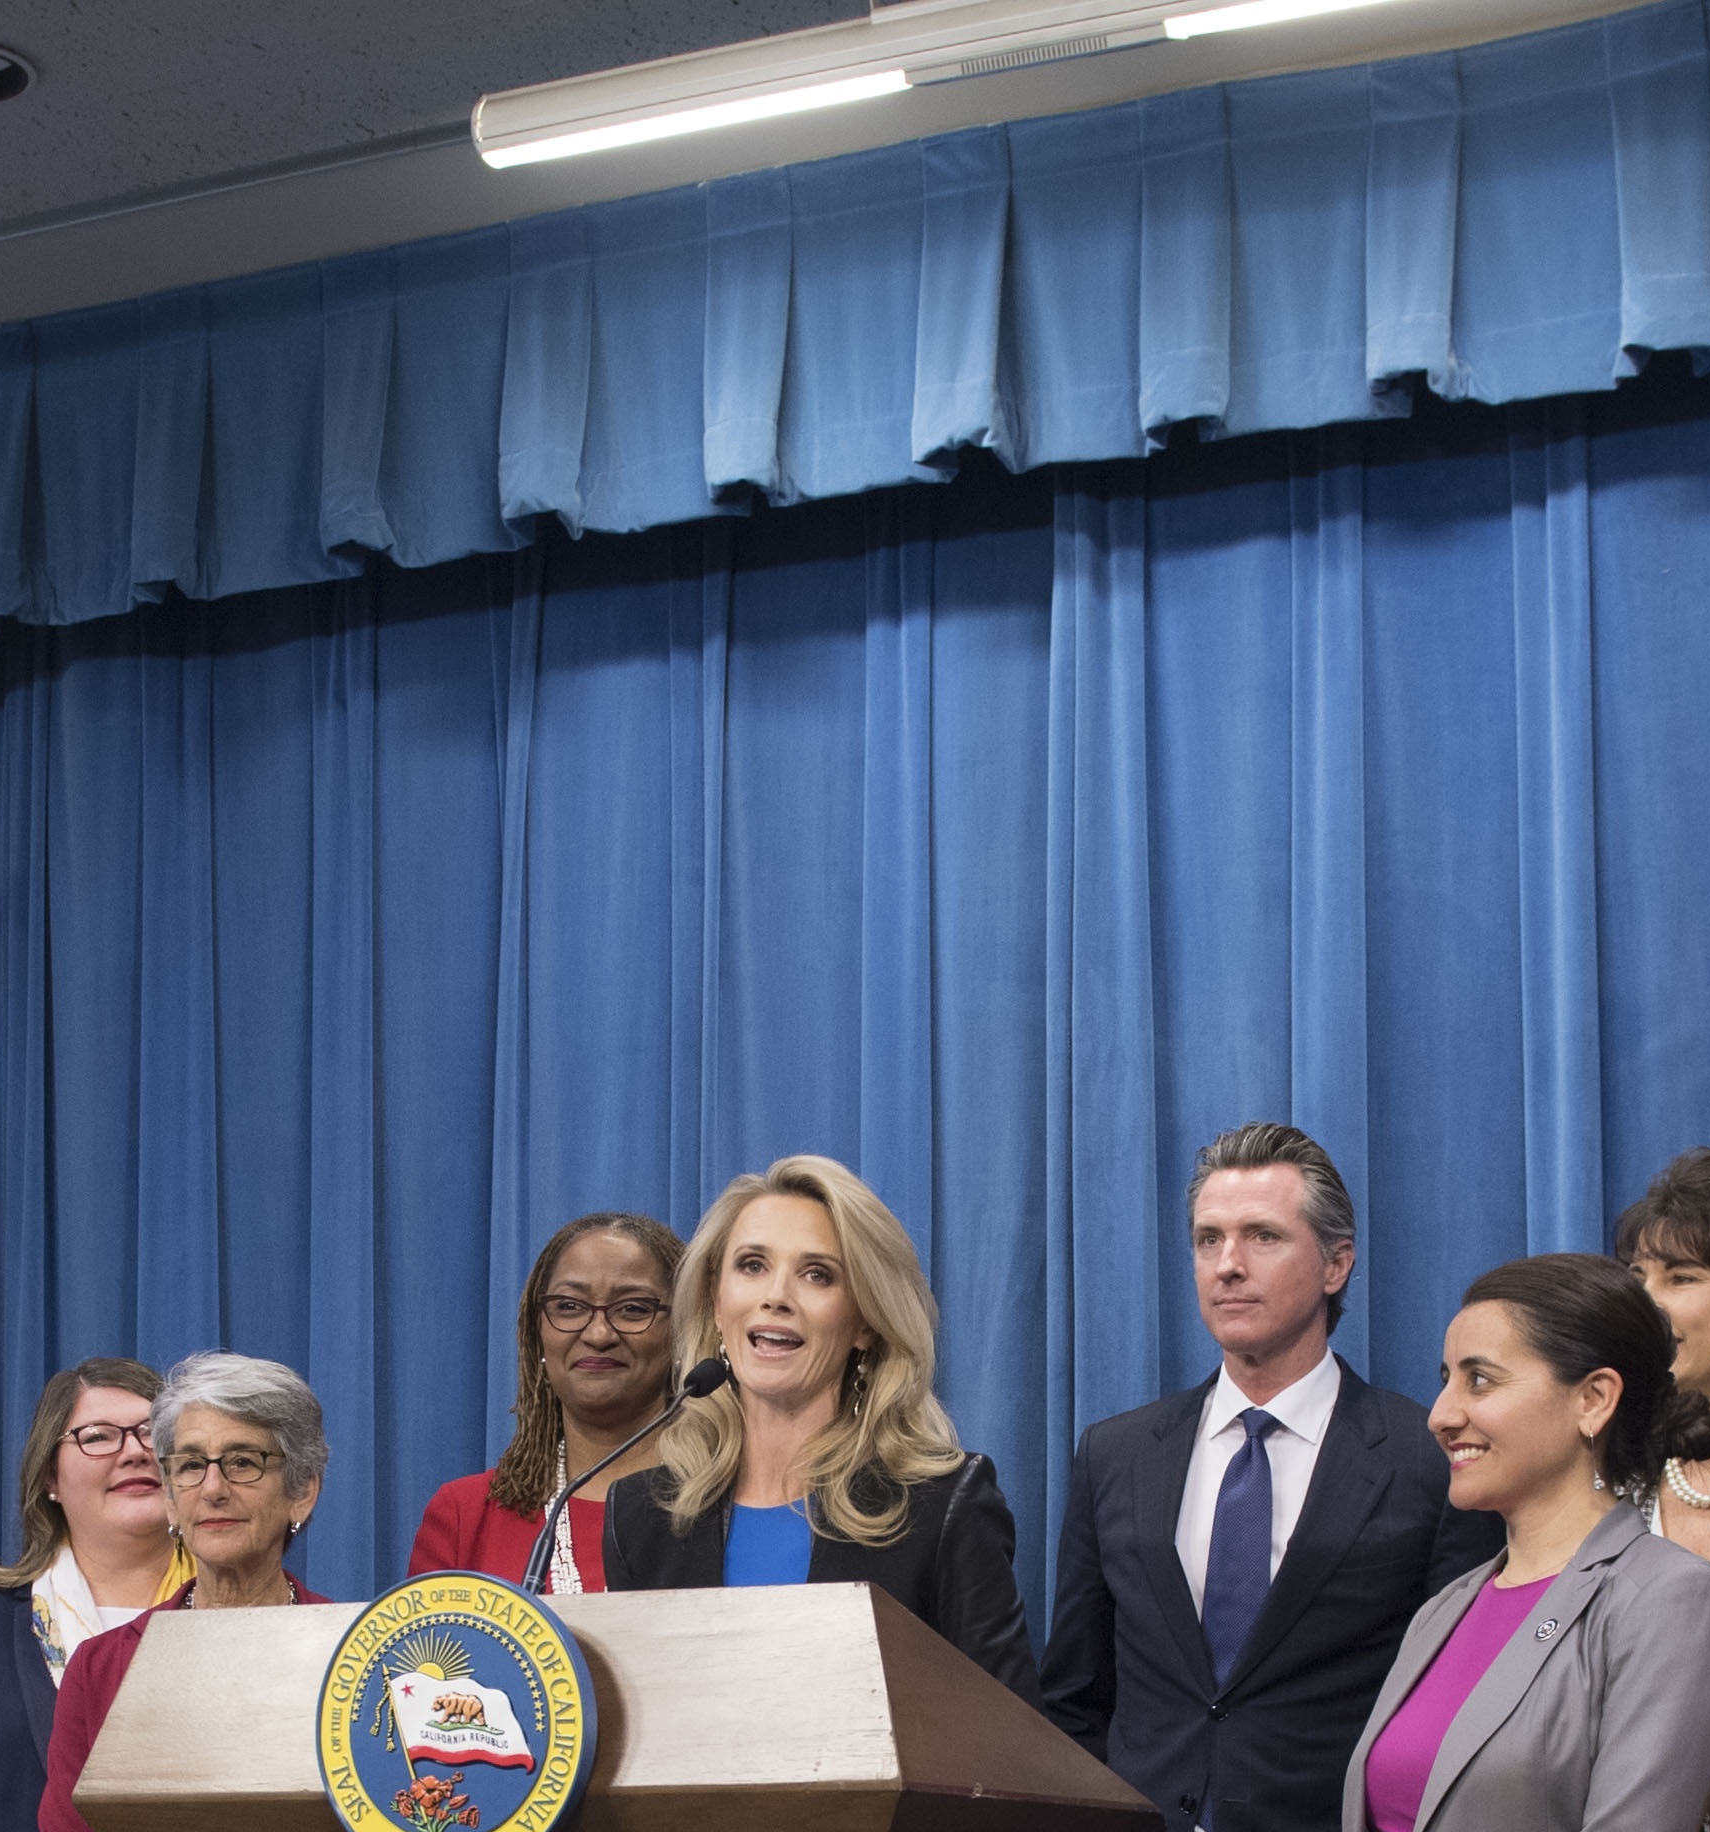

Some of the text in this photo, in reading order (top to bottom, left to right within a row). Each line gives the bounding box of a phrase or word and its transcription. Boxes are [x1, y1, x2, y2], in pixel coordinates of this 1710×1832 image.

[430, 1589, 446, 1602] OF
[448, 1589, 471, 1602] THE
[475, 1587, 541, 1647] STATE
[331, 1589, 431, 1703] GOVERNOR
[534, 1640, 565, 1681] OF
[420, 1729, 509, 1750] CALIFORNIA REPUBLIC
[516, 1680, 576, 1832] CALIFORNIA
[332, 1756, 371, 1824] SEAL
